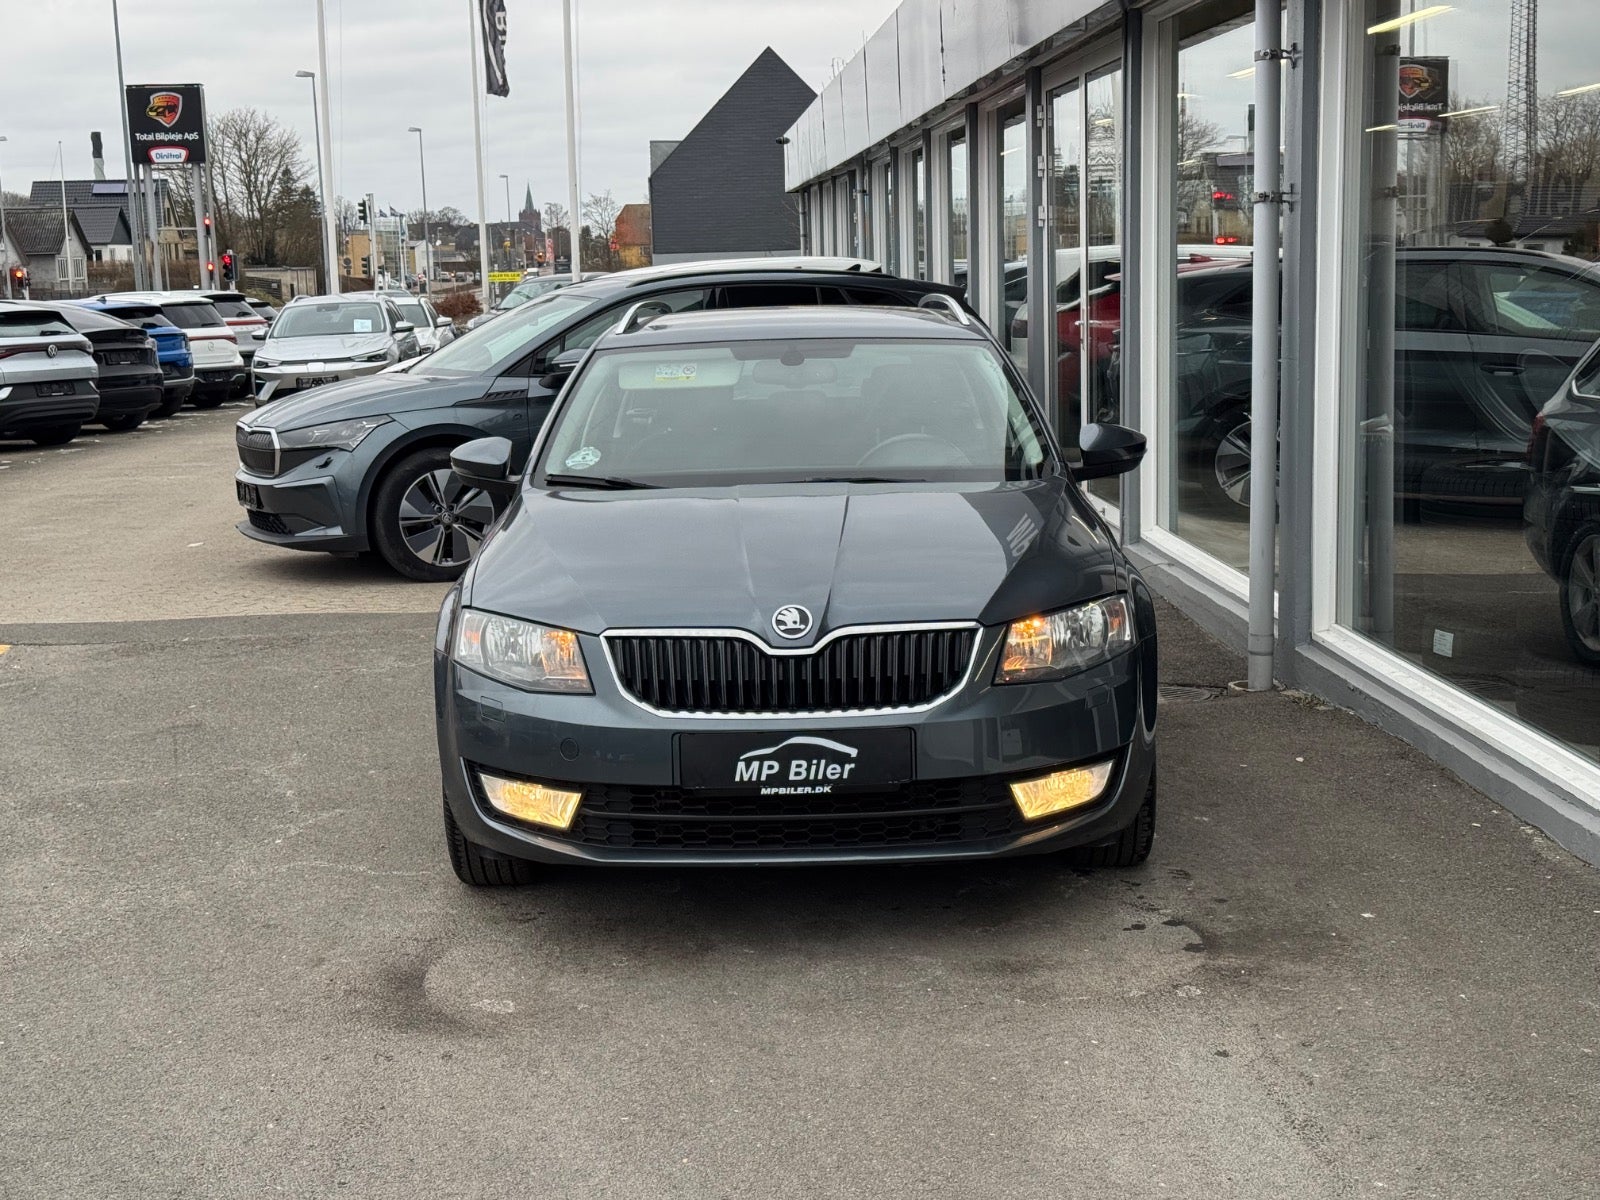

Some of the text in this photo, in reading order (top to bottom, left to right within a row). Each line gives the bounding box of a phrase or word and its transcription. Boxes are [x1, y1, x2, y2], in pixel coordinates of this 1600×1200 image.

[135, 131, 199, 142] Total Bilpleje ApS
[734, 759, 856, 782] MP Biler
[760, 785, 832, 795] MPBILER.DK
